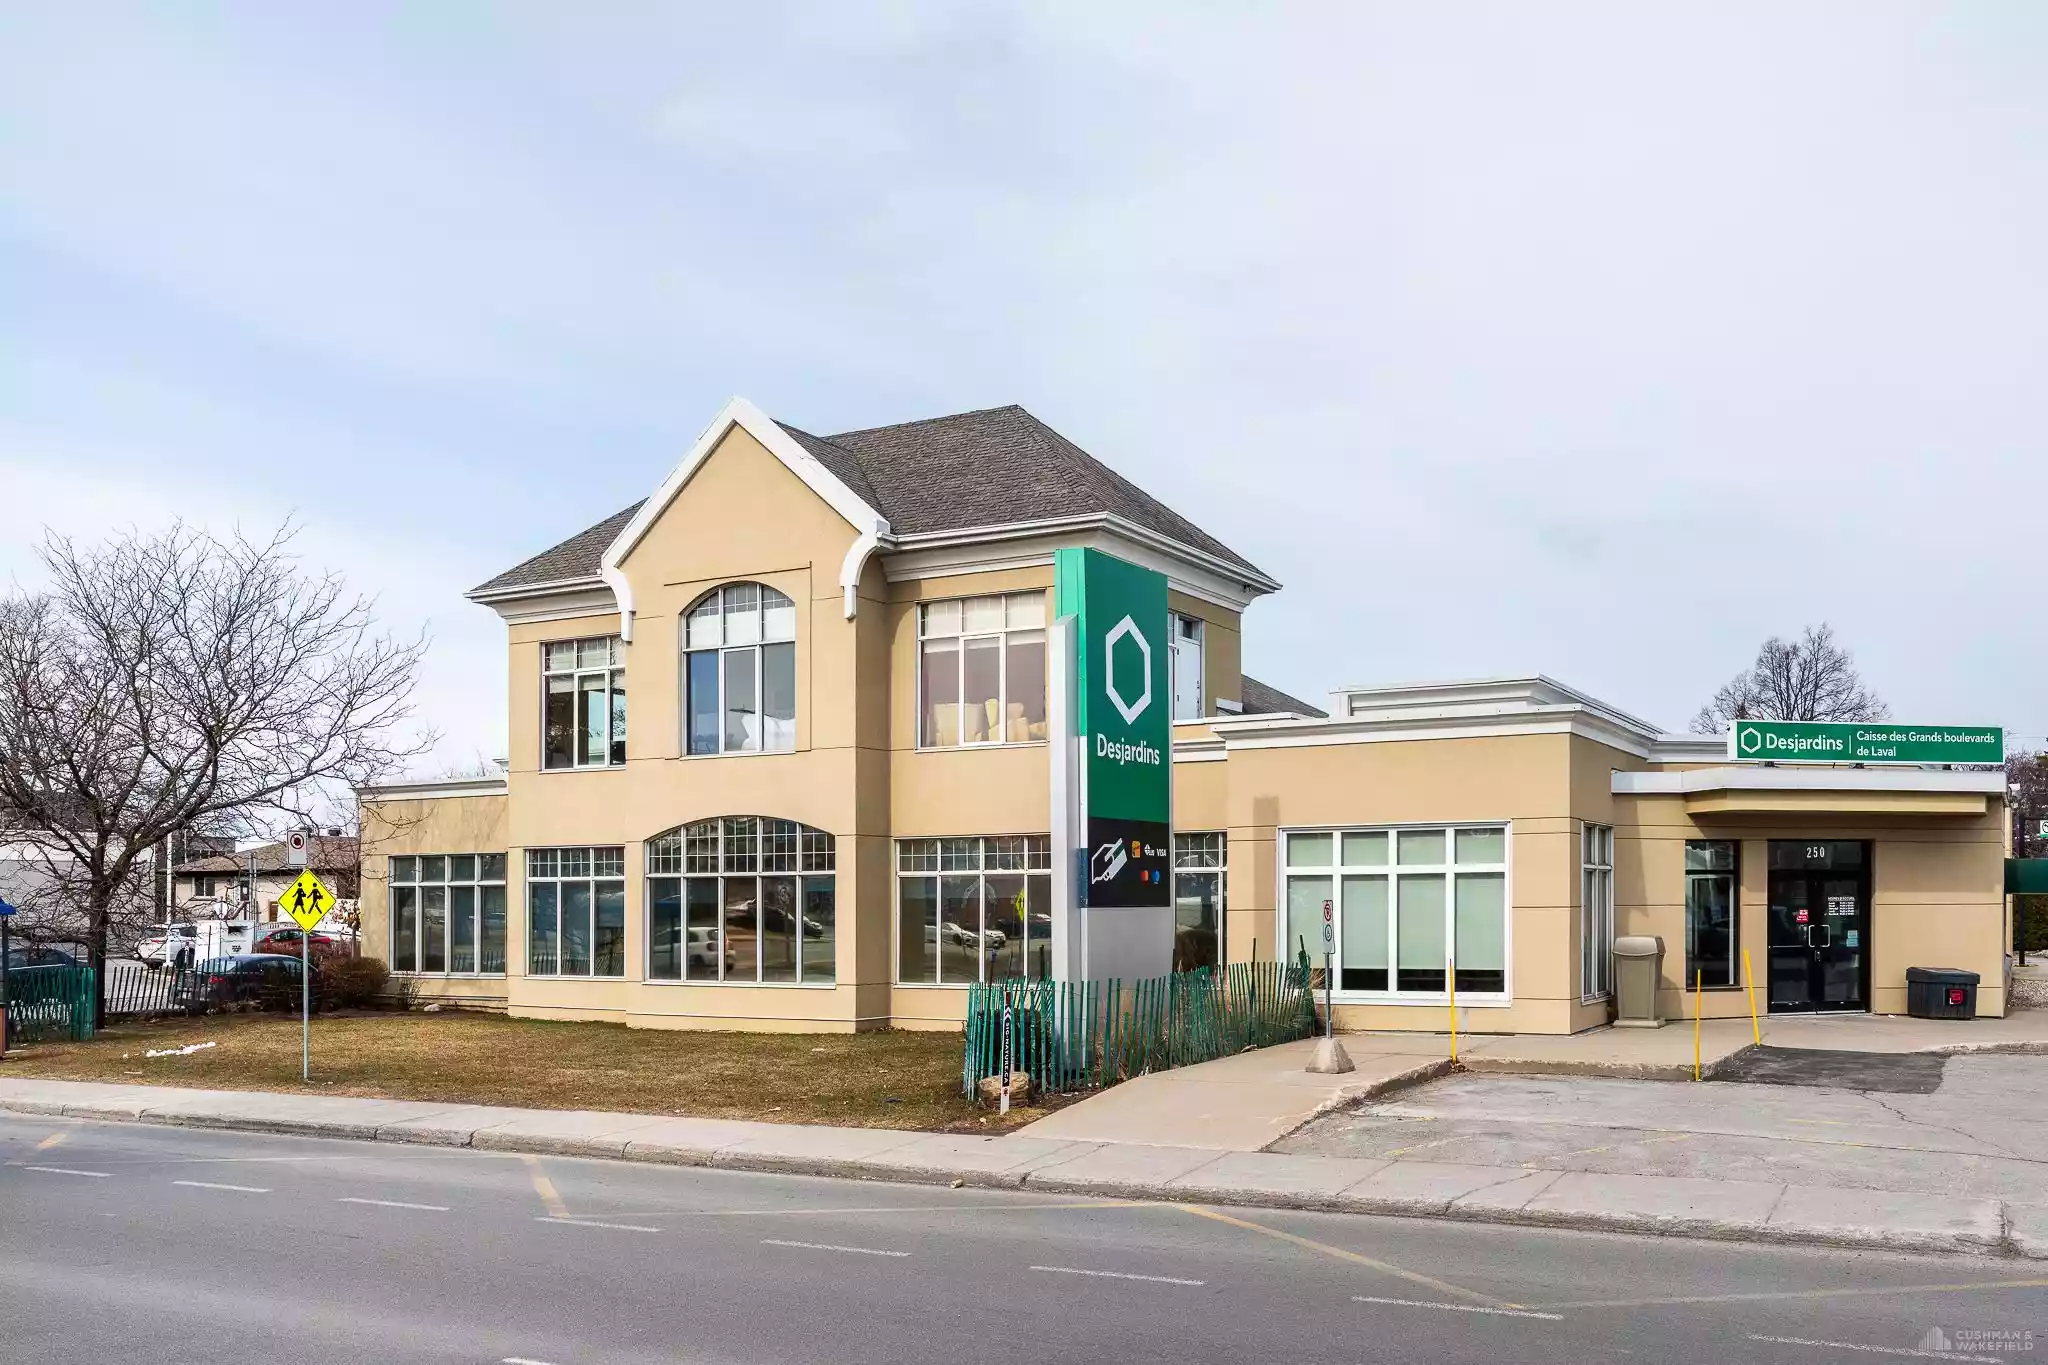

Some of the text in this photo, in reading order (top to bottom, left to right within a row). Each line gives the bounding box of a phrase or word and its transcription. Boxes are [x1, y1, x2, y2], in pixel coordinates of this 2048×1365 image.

[1766, 733, 1844, 753] Desjardins
[1856, 730, 1995, 744] Caisse des Grands boulevards
[1097, 732, 1160, 765] Desjardins
[1856, 745, 1897, 757] de Laval
[1156, 848, 1167, 857] VISA
[1806, 846, 1825, 858] 250
